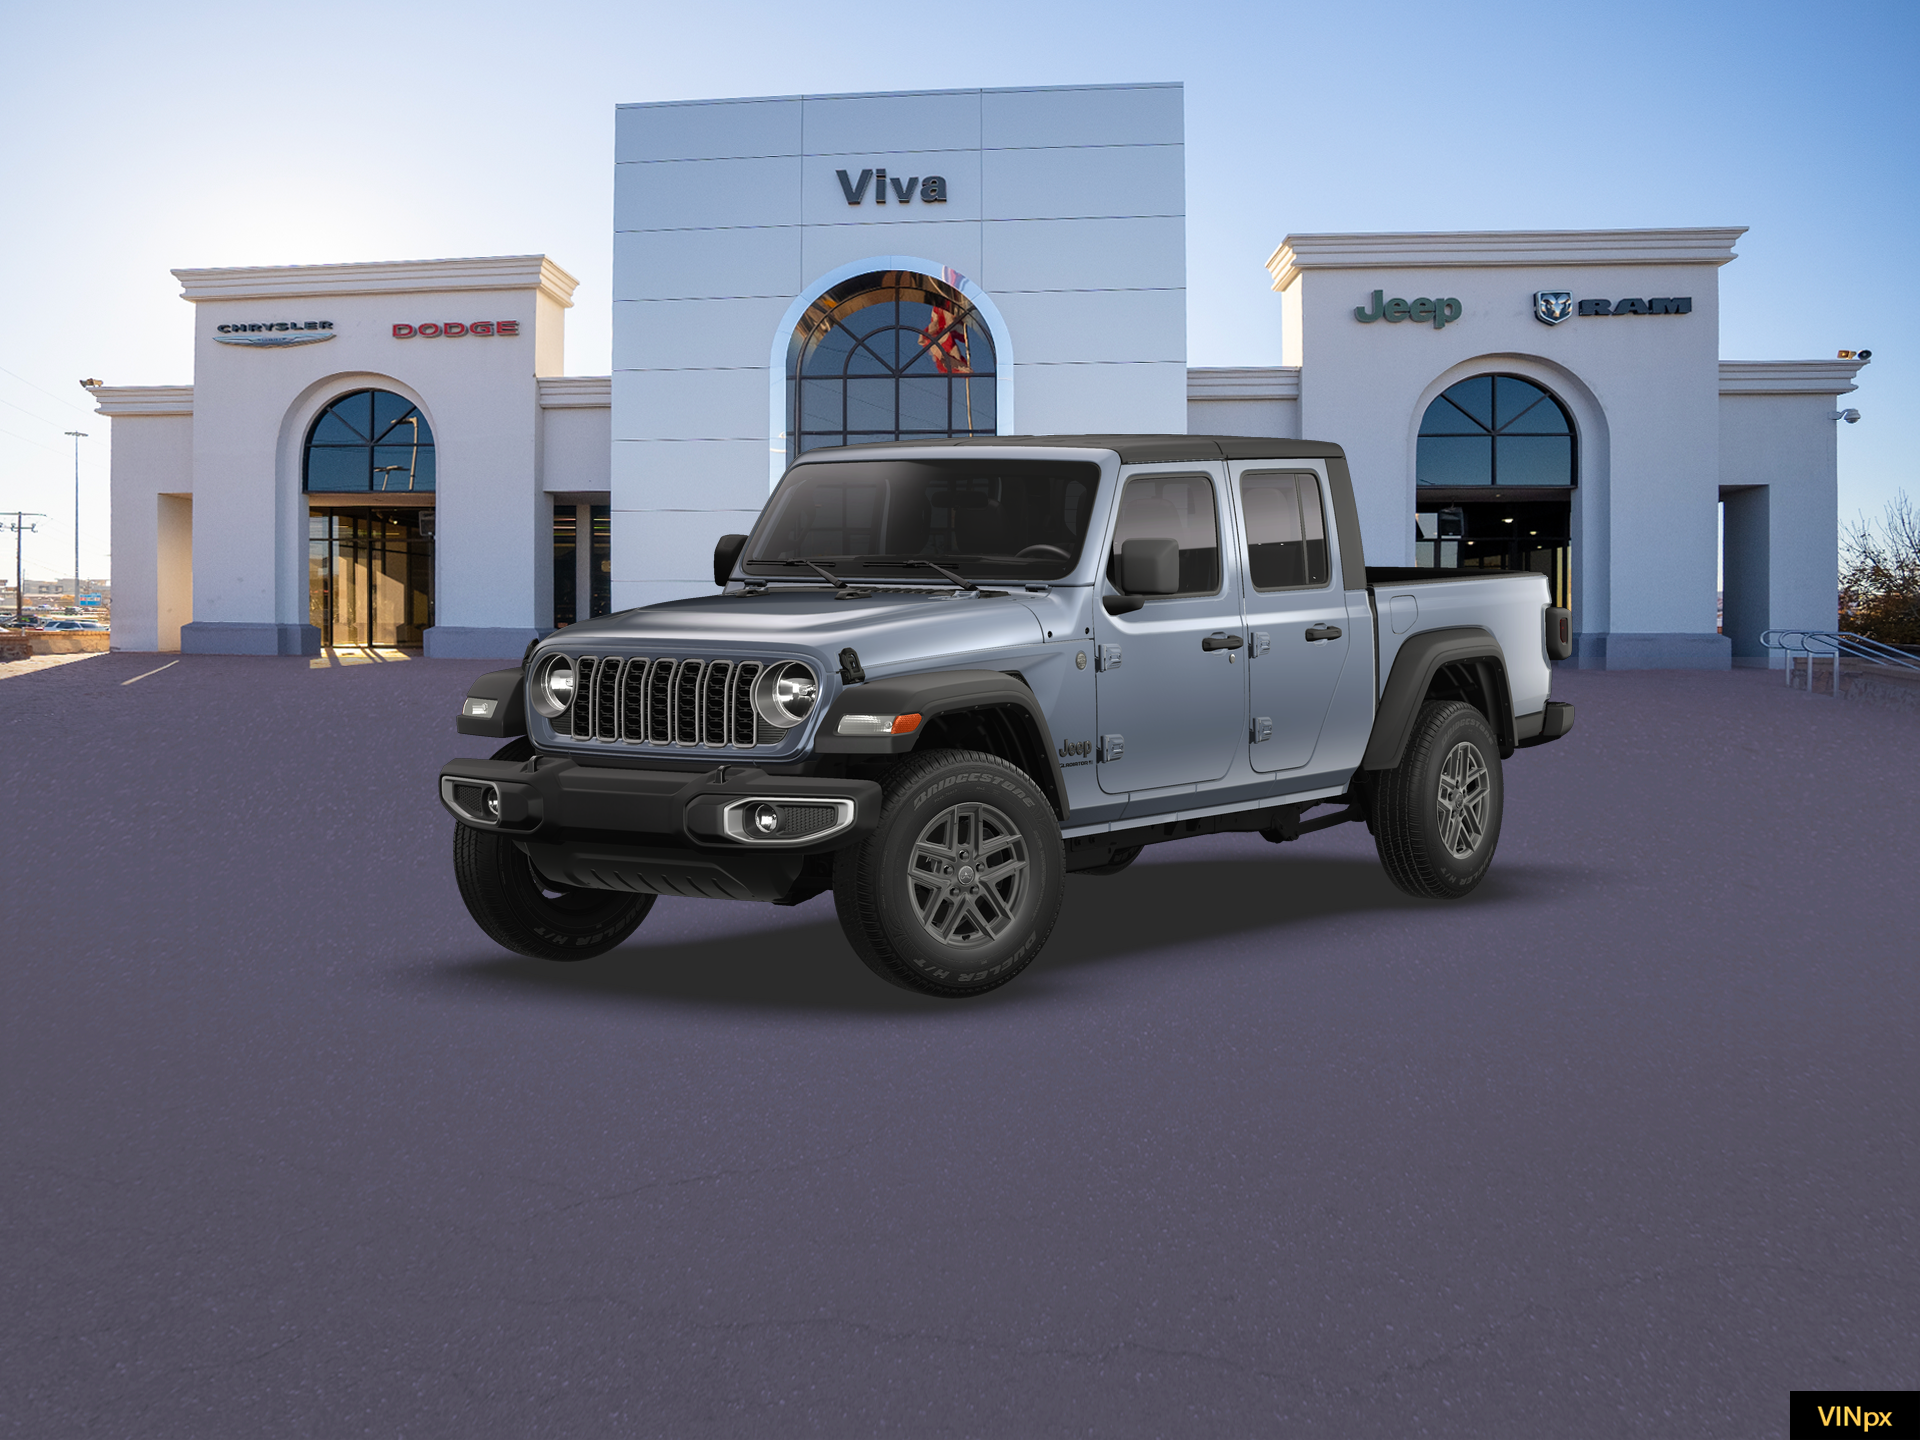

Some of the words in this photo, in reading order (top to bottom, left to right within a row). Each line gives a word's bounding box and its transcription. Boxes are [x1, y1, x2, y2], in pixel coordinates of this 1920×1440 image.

[835, 168, 947, 205] Viva
[1354, 289, 1463, 329] Jeep
[1578, 296, 1693, 316] RAM
[217, 320, 334, 334] CHRYSLER
[392, 320, 520, 339] DODGE
[1442, 718, 1494, 748] BRIDGESTONE
[1058, 738, 1093, 758] Jeep
[913, 772, 1036, 812] BRIDGESTONE
[533, 926, 569, 945] H/T
[957, 930, 1037, 982] DUELER
[912, 958, 951, 979] H/T
